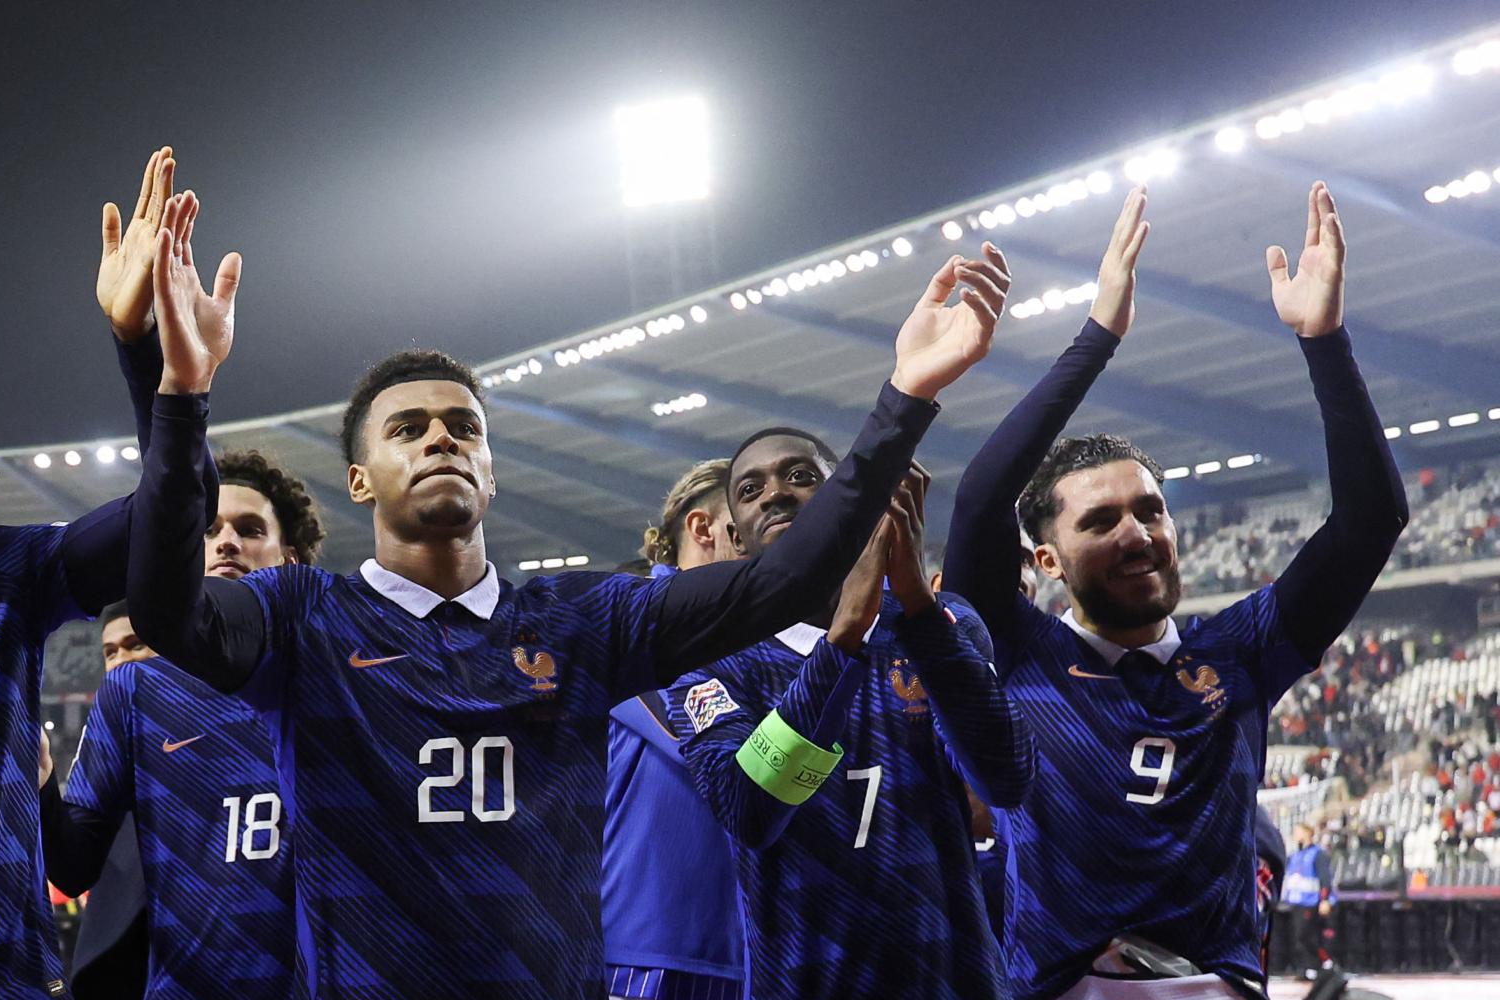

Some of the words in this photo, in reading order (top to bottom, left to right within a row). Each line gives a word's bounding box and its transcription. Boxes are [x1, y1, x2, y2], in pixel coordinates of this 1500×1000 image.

[418, 737, 515, 822] 20
[847, 766, 882, 848] 7
[1126, 738, 1174, 805] 9
[223, 793, 281, 862] 18
